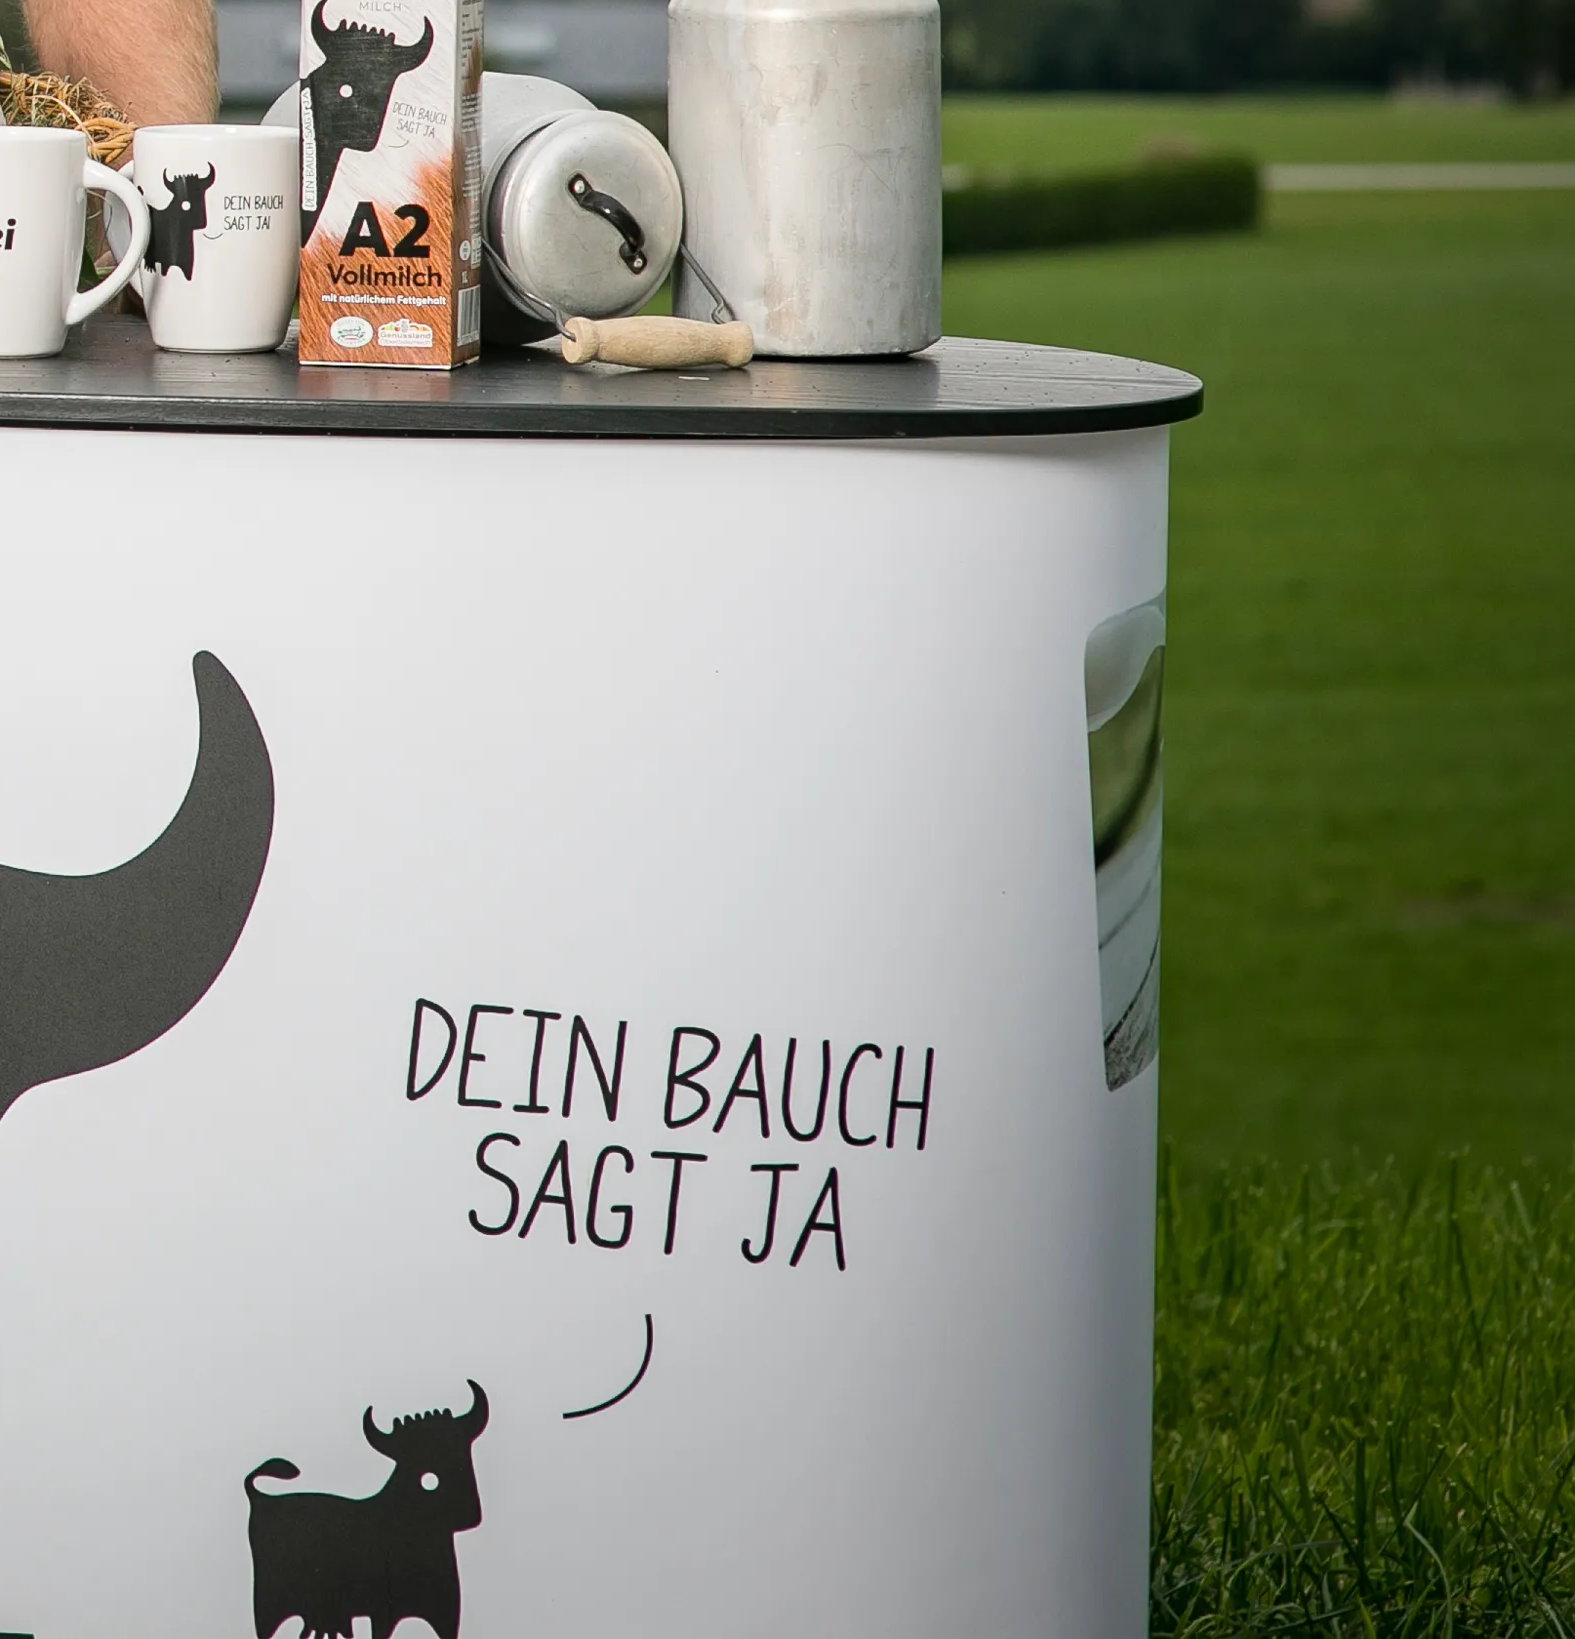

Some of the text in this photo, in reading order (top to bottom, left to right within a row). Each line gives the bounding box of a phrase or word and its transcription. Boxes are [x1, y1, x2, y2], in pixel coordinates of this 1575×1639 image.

[359, 2, 402, 12] MILCH
[393, 102, 447, 125] DEIN BAUCH
[397, 118, 435, 138] SAGT JA
[305, 143, 314, 176] BAUCH
[224, 195, 283, 210] DEIN BAUCH
[305, 181, 315, 208] DEIN
[224, 216, 252, 230] SAGT
[339, 201, 431, 258] A2
[327, 263, 442, 287] Vollmilch
[321, 293, 446, 307] mit natürlichem Fettgehalt
[406, 998, 935, 1150] DEIN BAUCH
[468, 1132, 846, 1271] SAGT JA
